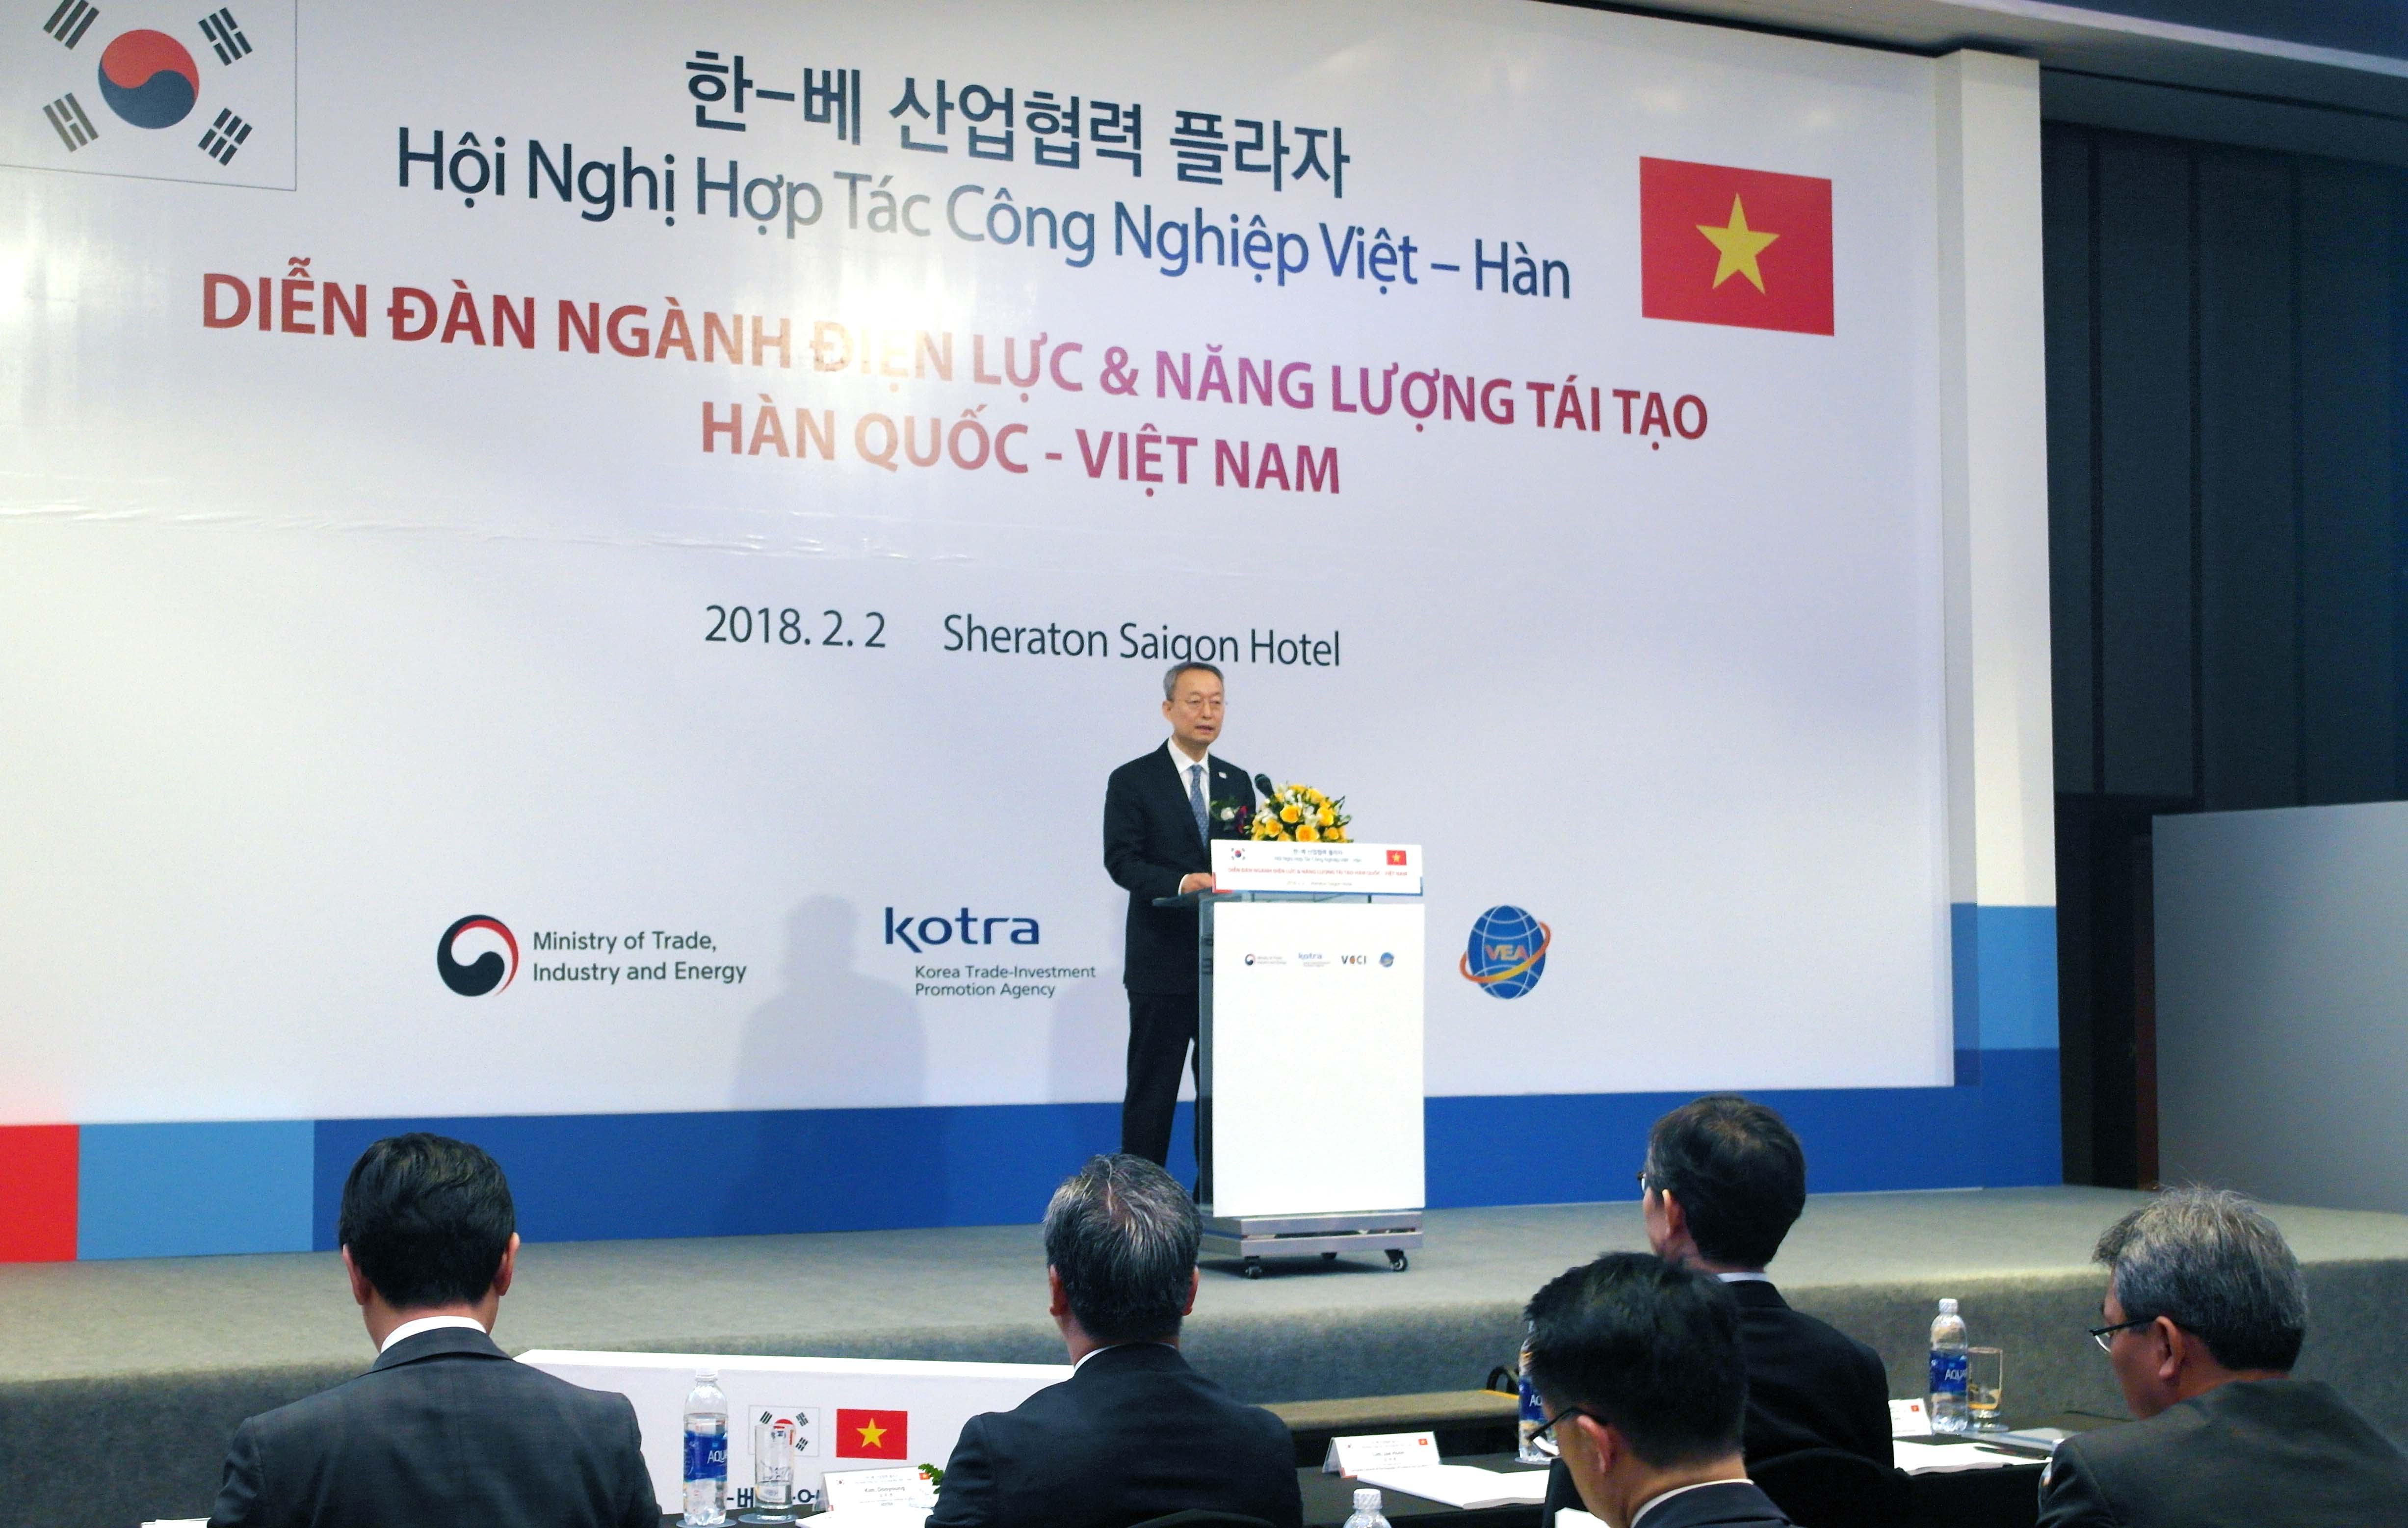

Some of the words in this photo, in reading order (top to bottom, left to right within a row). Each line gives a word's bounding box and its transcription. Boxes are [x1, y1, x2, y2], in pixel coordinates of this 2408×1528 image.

[686, 51, 860, 145] 한-베
[889, 77, 1141, 177] 산업협력
[1170, 110, 1350, 198] 플라자
[399, 127, 505, 208] Hội
[529, 140, 675, 227] Nghị
[697, 157, 822, 238] Hợp
[833, 171, 930, 236] Tác
[948, 184, 1095, 267] Công
[1115, 201, 1309, 287] Nghiệp
[1319, 223, 1417, 294] Việt
[1475, 238, 1570, 299] Hàn
[204, 257, 366, 338] DIỄN
[387, 279, 534, 349] ĐÀN
[559, 297, 789, 367] NGÀNH
[974, 332, 1083, 404] LỰC
[1100, 346, 1139, 396] &
[1156, 344, 1313, 409] NĂNG
[1332, 363, 1514, 432] LƯỢNG
[1526, 375, 1600, 431] TÁI
[1613, 389, 1707, 450] TẠO
[703, 394, 834, 460] HÀN
[855, 404, 1028, 474] QUỐC
[1076, 423, 1198, 497] VIỆT
[1215, 439, 1339, 494] NAM
[705, 605, 811, 645] 2018.
[822, 610, 853, 647] 2.
[865, 612, 885, 648] 2
[944, 614, 1107, 657] Sheraton
[1120, 623, 1238, 662] Saigon
[1252, 629, 1339, 666] Hotel
[534, 931, 617, 954] Ministry
[624, 931, 644, 949] of
[652, 931, 716, 952] Trade,
[885, 907, 1039, 953] kotra
[534, 963, 620, 985] Industry
[627, 962, 666, 980] and
[675, 961, 746, 984] Energy
[916, 966, 960, 978] Korea
[965, 965, 1096, 978] Trade-Investment
[1485, 945, 1529, 961] VEA
[916, 983, 995, 996] Promotion
[1000, 983, 1055, 999] Agency
